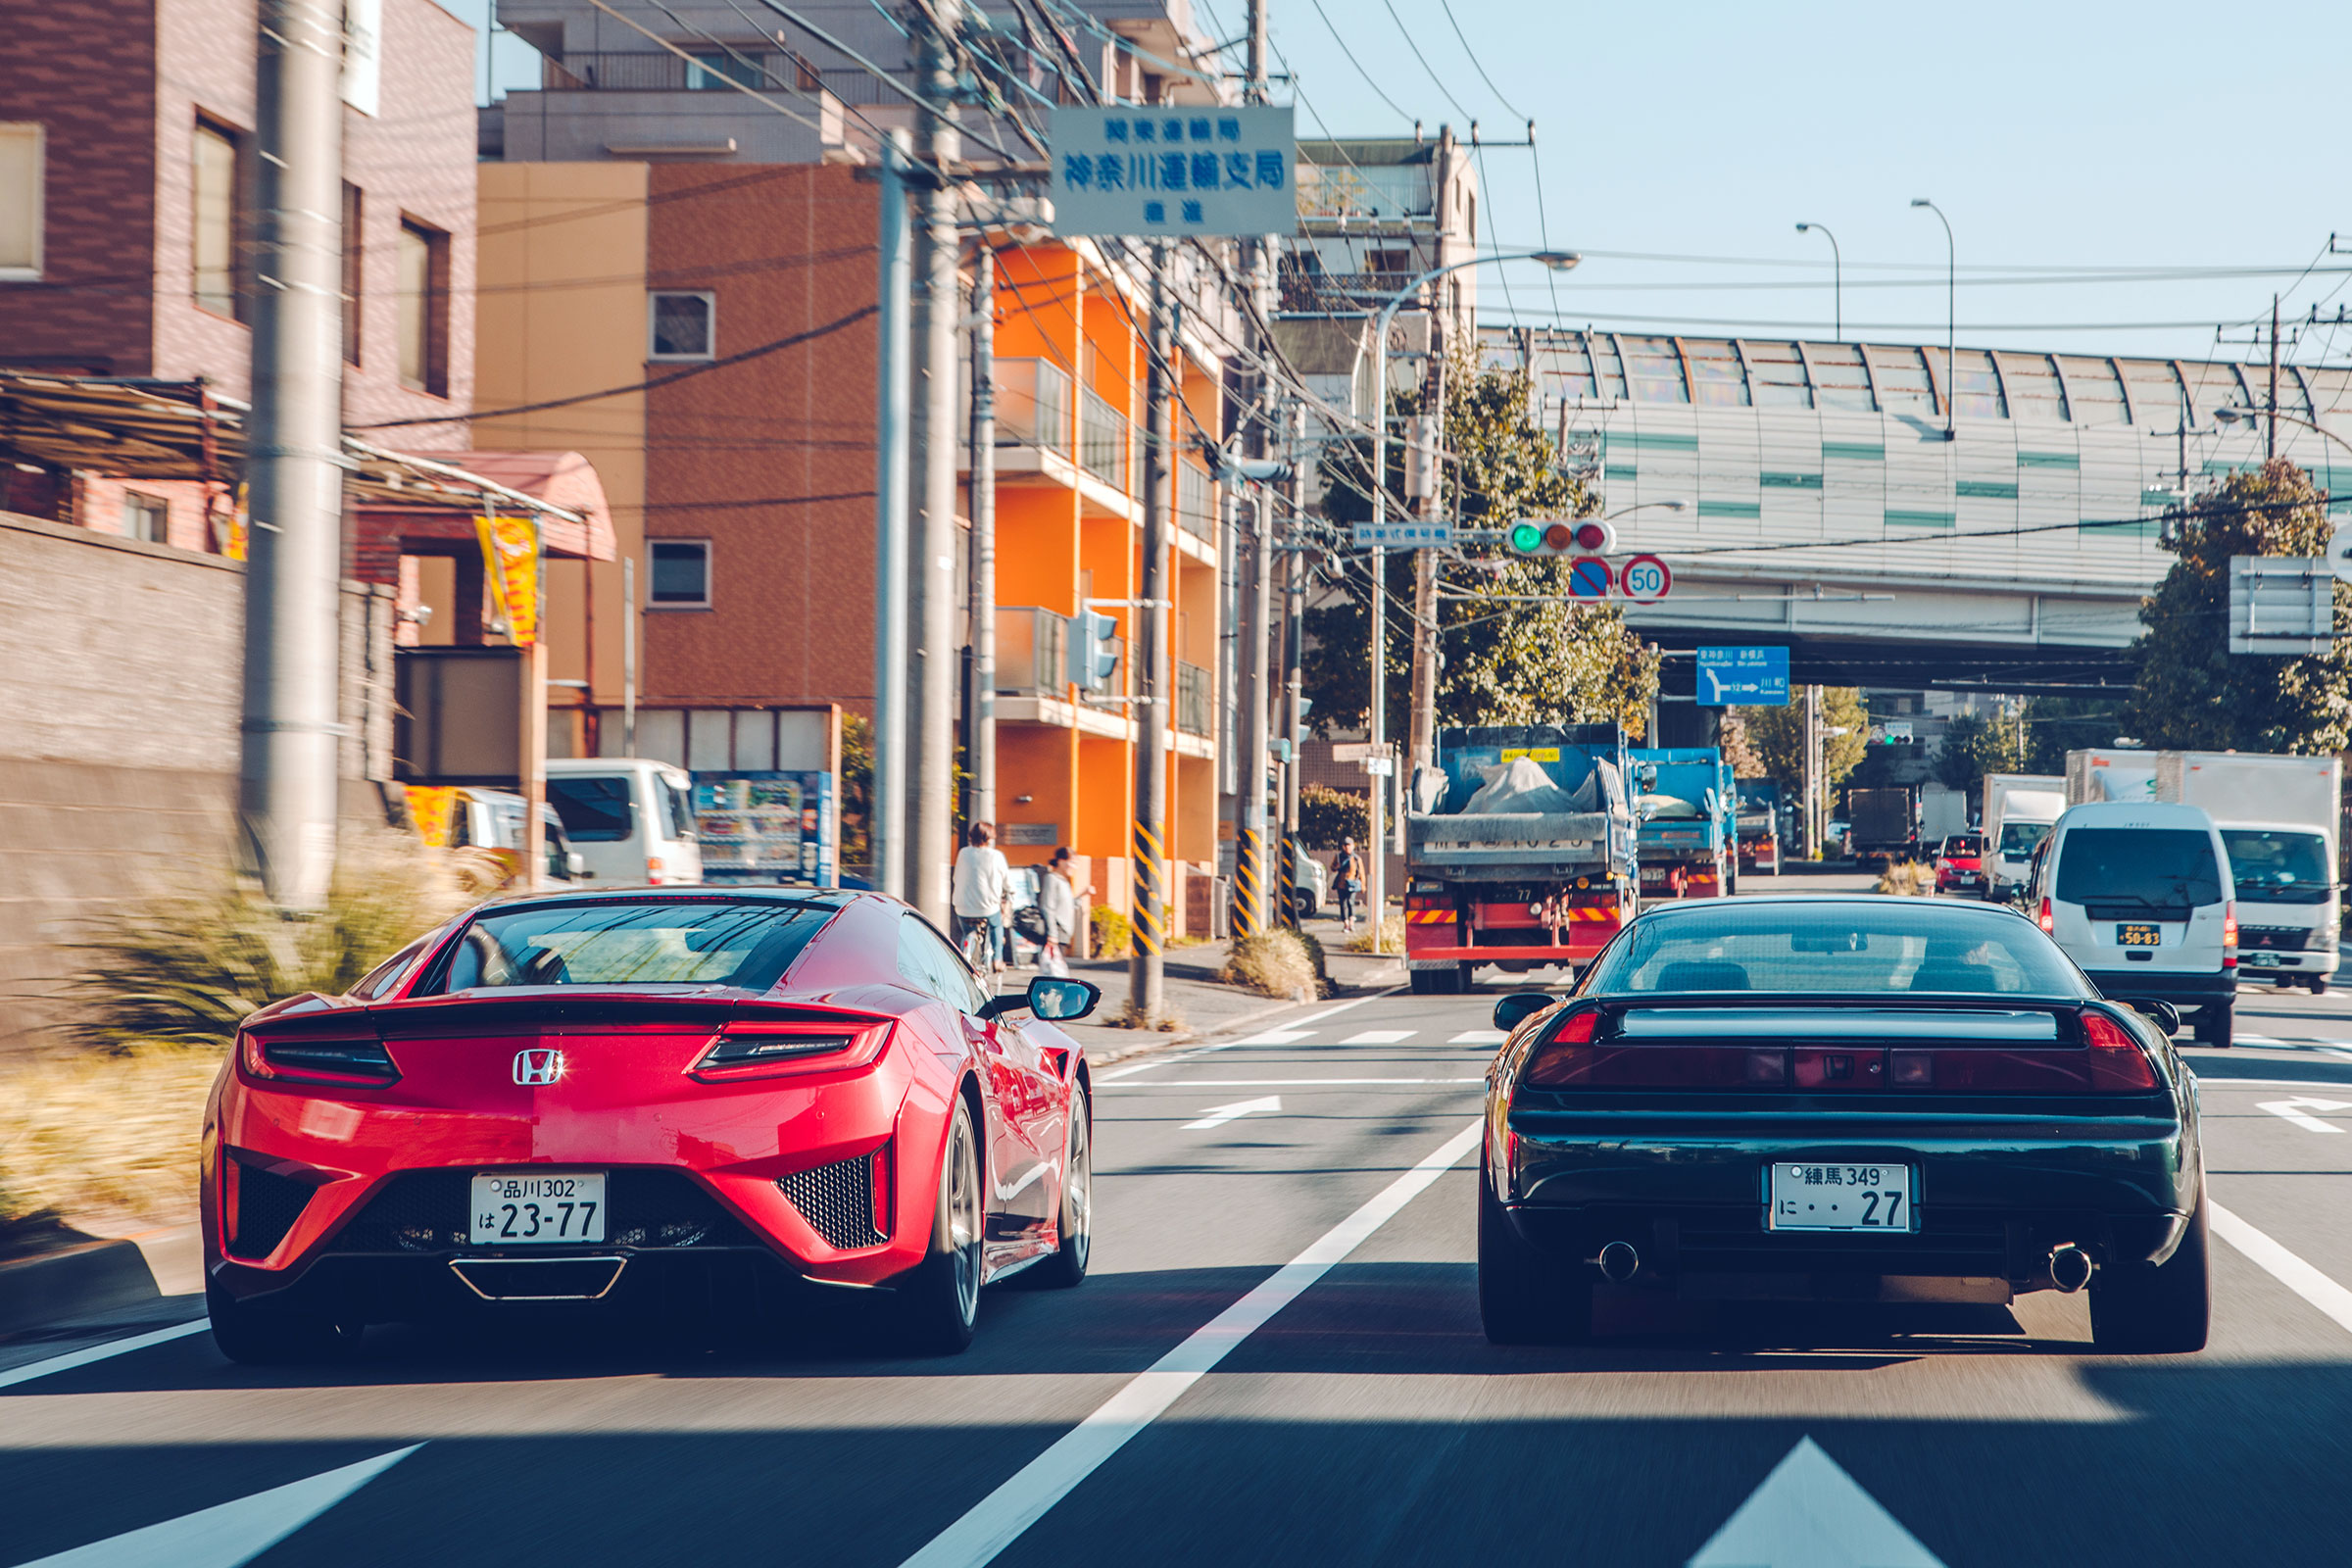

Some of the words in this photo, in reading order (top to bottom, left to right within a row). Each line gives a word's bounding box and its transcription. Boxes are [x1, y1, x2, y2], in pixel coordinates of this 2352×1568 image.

[1063, 148, 1286, 192] 神奈川運輸支局
[1632, 568, 1660, 591] 50
[2125, 932, 2160, 945] 50-83
[501, 1201, 597, 1238] 23-77
[1861, 1191, 1903, 1226] 27
